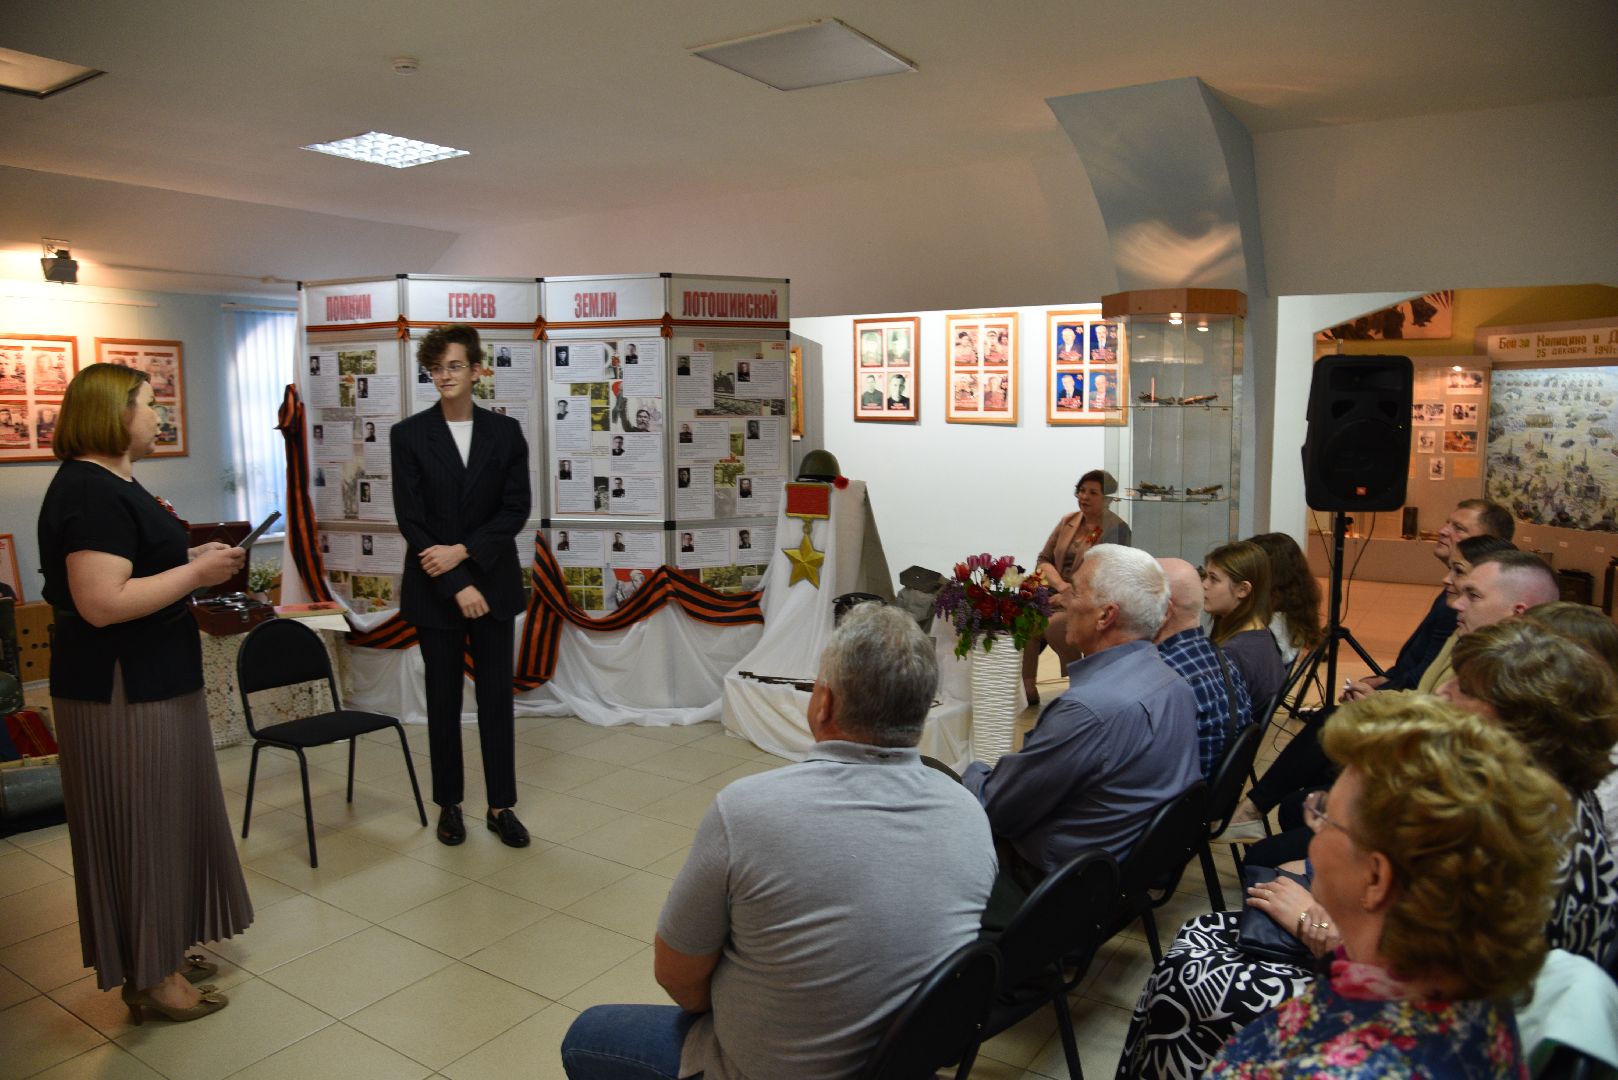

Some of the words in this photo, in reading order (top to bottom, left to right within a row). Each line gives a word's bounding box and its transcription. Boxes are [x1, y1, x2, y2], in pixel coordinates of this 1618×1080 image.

[448, 293, 496, 318] ГЕРОЕВ
[574, 292, 617, 318] ЗЕМЛИ
[682, 289, 778, 319] ЛОТОШИНСКОЙ
[1536, 348, 1546, 358] 25
